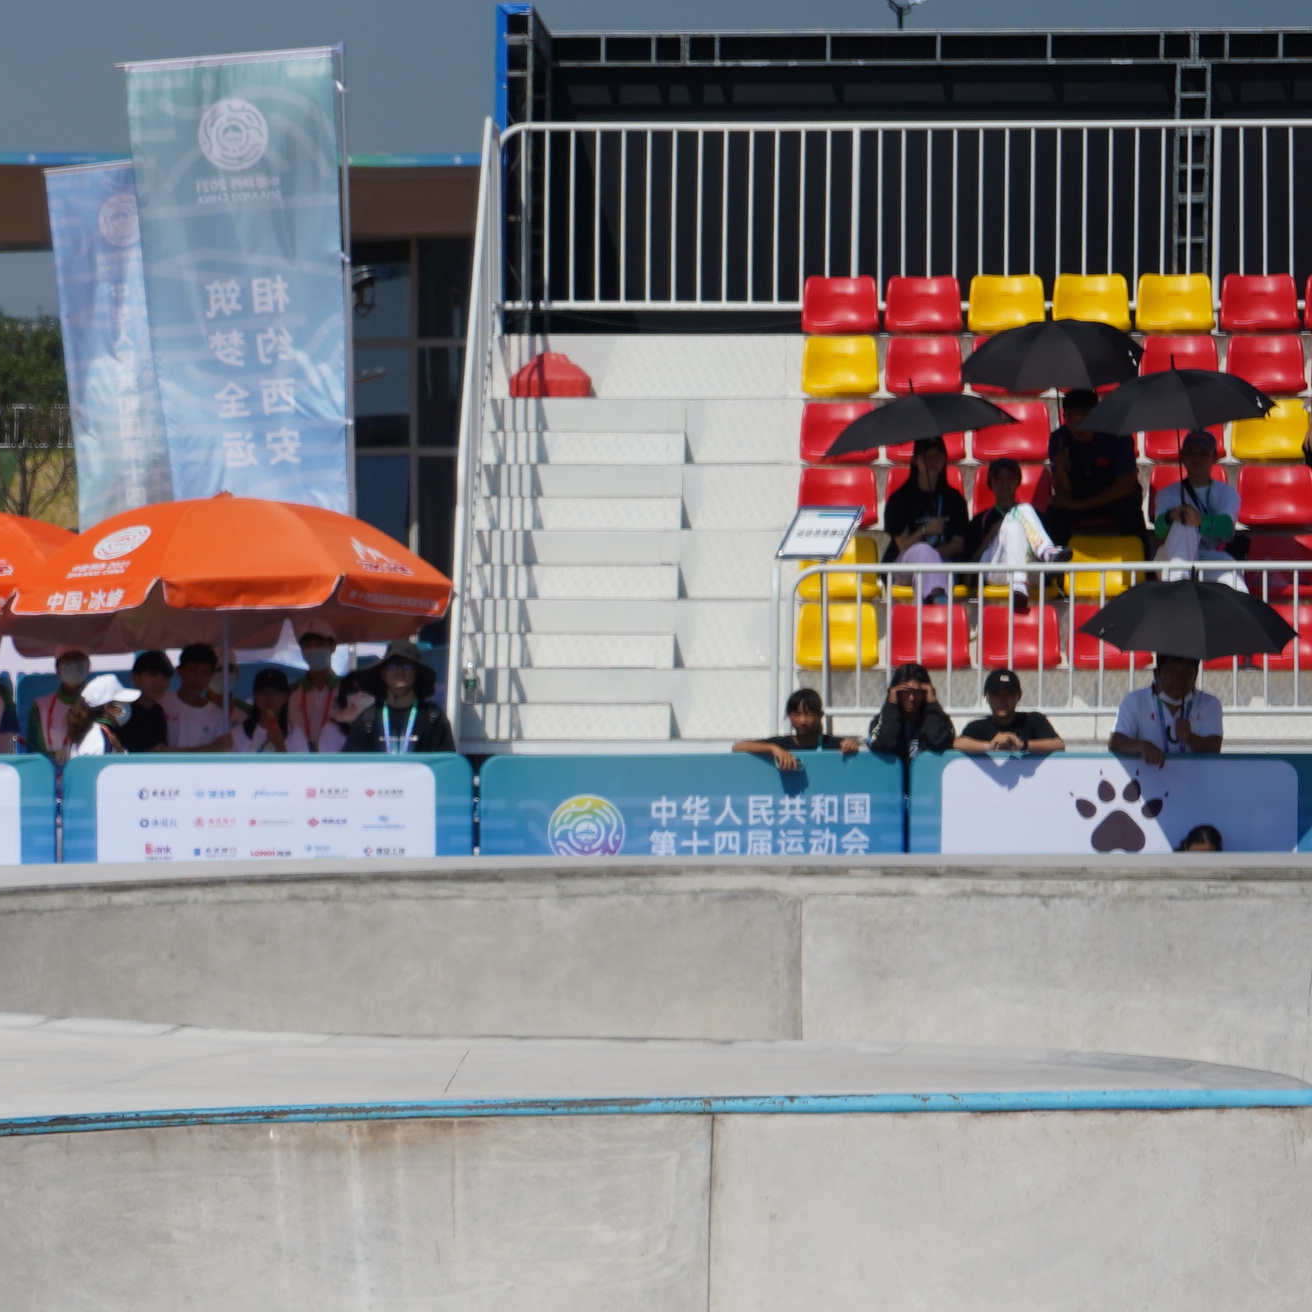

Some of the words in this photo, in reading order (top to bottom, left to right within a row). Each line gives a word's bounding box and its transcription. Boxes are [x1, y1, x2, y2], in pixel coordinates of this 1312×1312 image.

[649, 793, 871, 827] 中华人民共和国
[649, 826, 870, 856] 第十四届运动会
